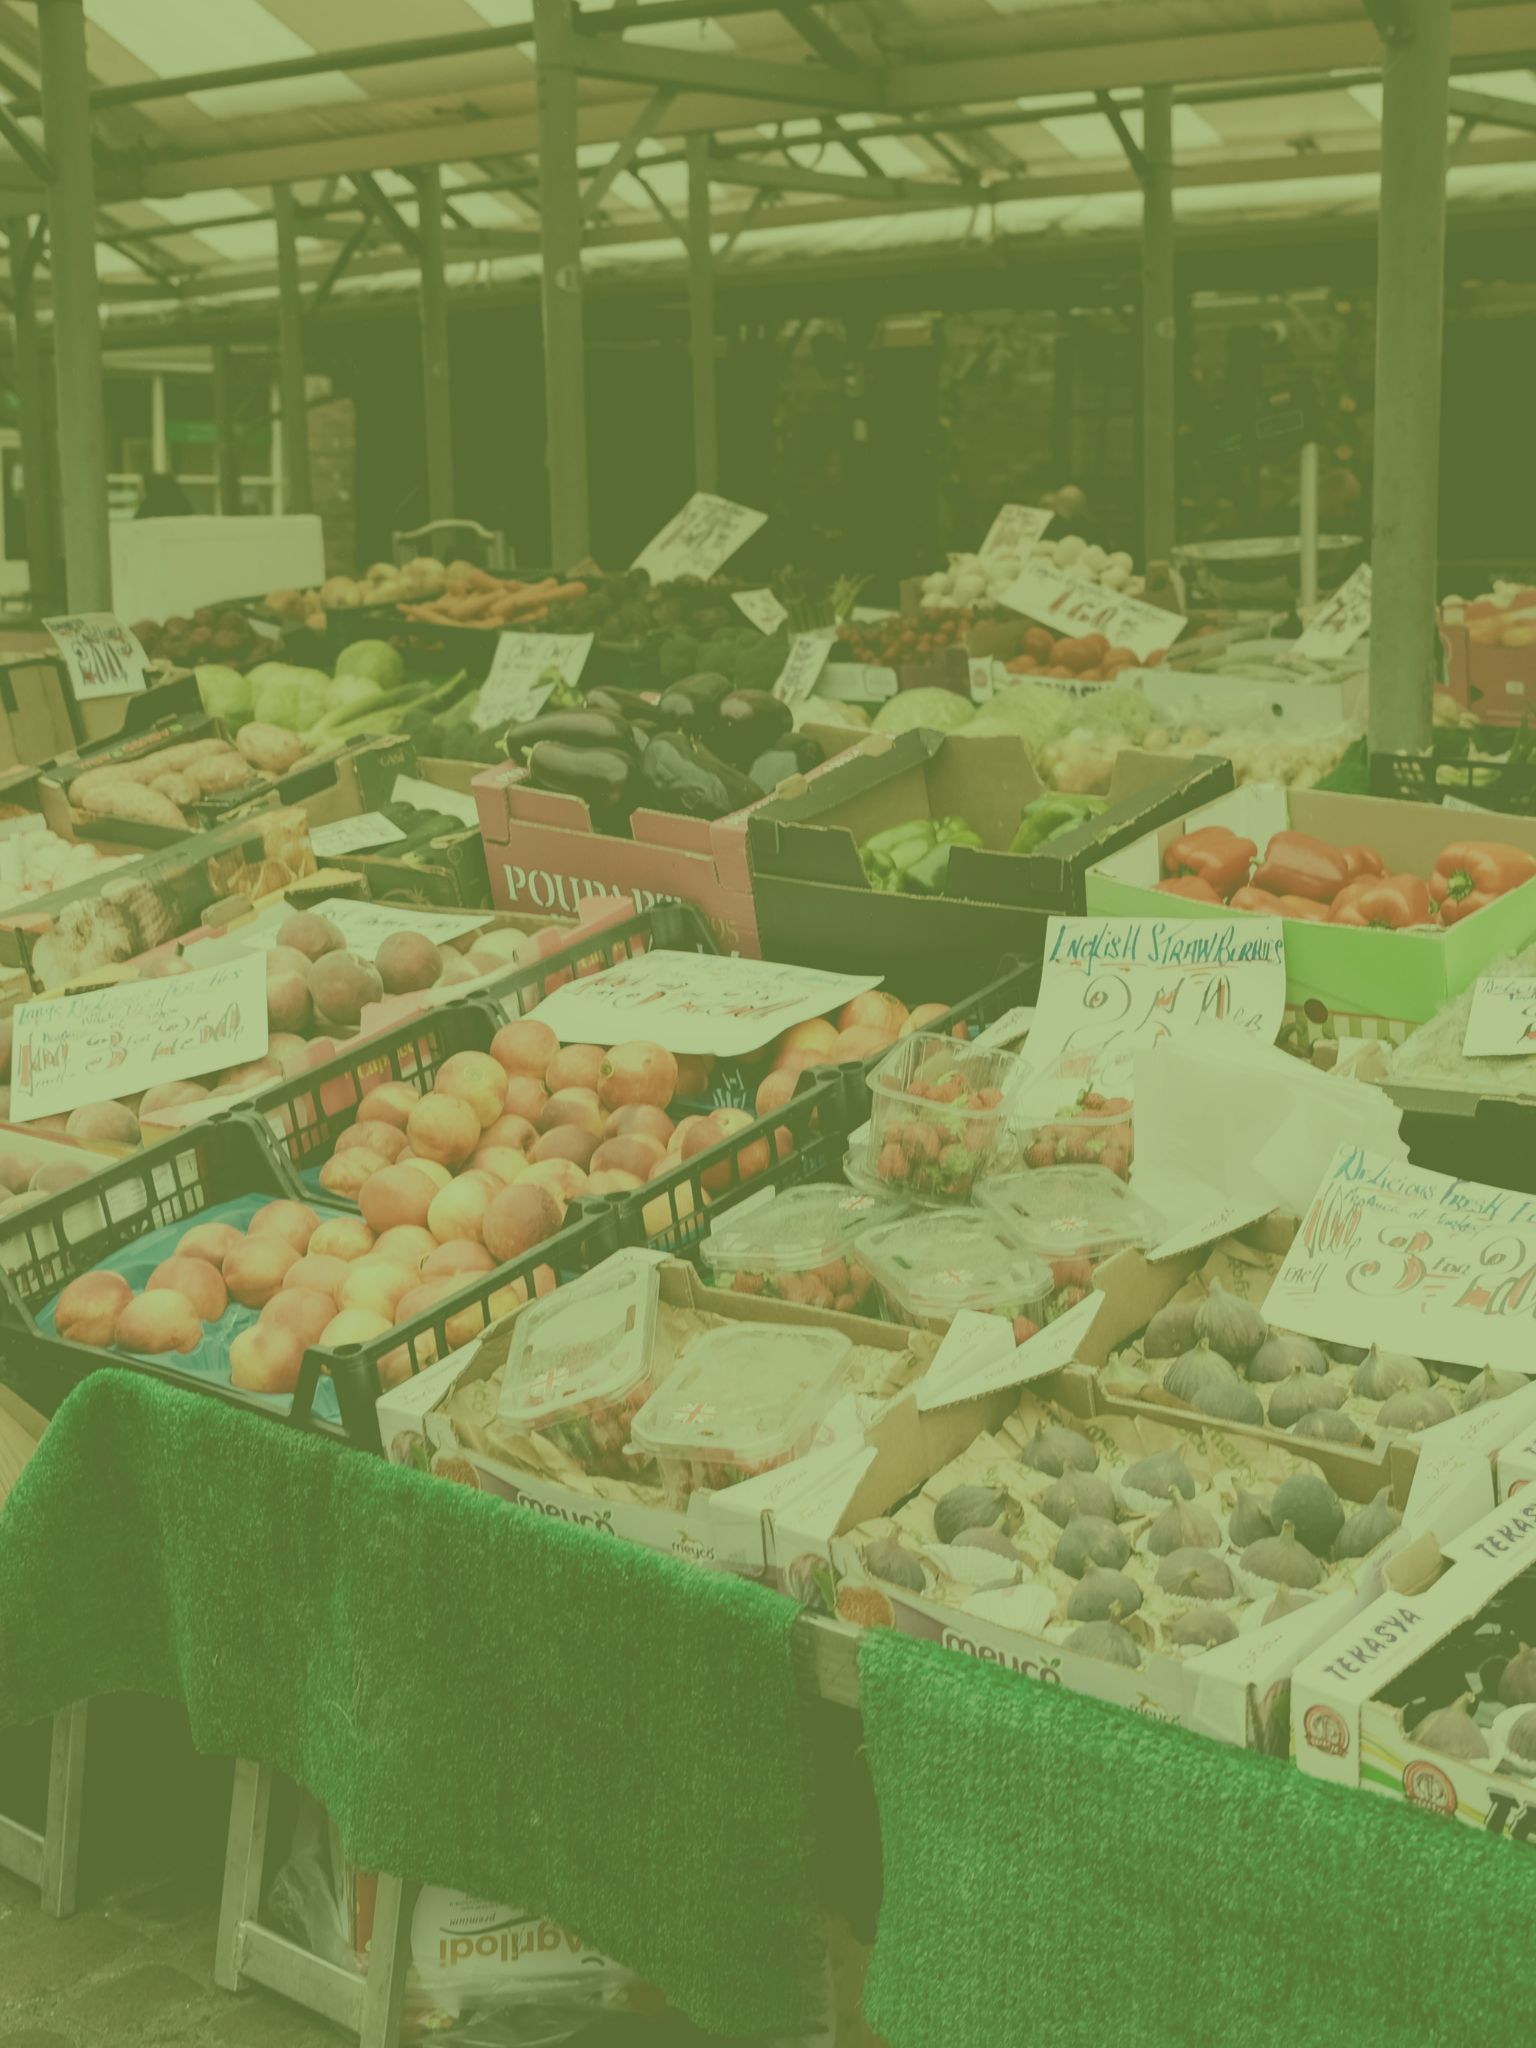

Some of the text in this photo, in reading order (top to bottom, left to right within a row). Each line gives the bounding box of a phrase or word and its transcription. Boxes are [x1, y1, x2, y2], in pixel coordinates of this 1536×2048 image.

[1346, 1225, 1434, 1298] 3
[1474, 1502, 1536, 1559] TEKAS
[439, 1919, 583, 1969] Agrilodi
[449, 1912, 497, 1926] premium
